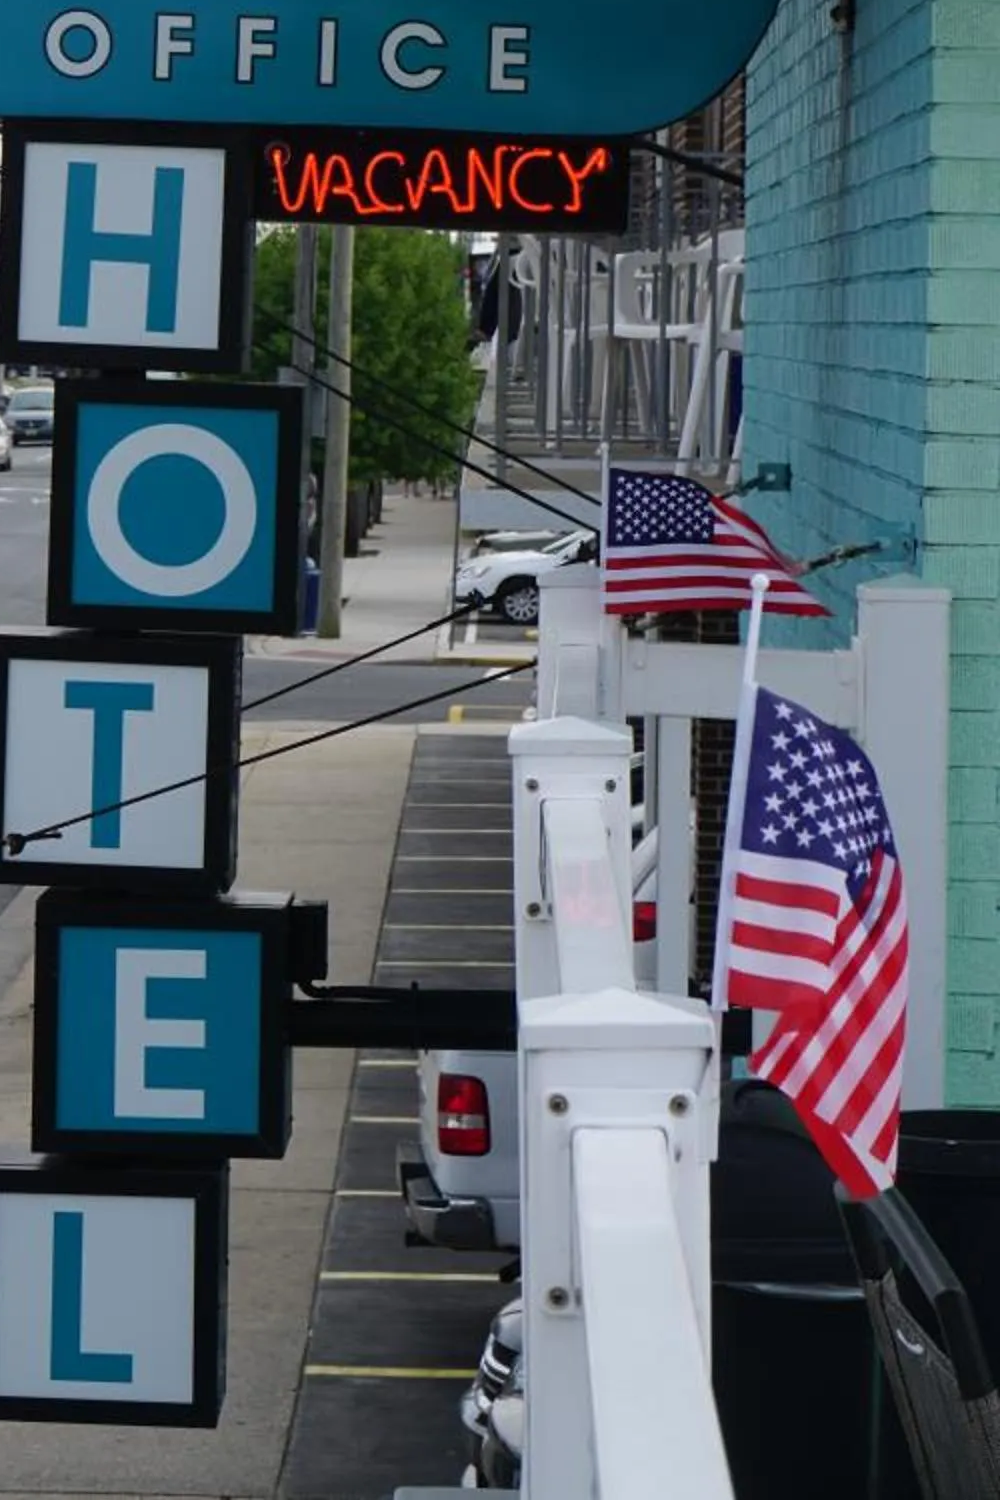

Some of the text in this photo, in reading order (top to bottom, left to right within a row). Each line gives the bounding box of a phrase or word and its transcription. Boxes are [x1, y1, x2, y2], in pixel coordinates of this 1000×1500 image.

[44, 9, 530, 94] OFFICE
[271, 146, 606, 214] VACANCY
[49, 160, 258, 1384] HOTEL
